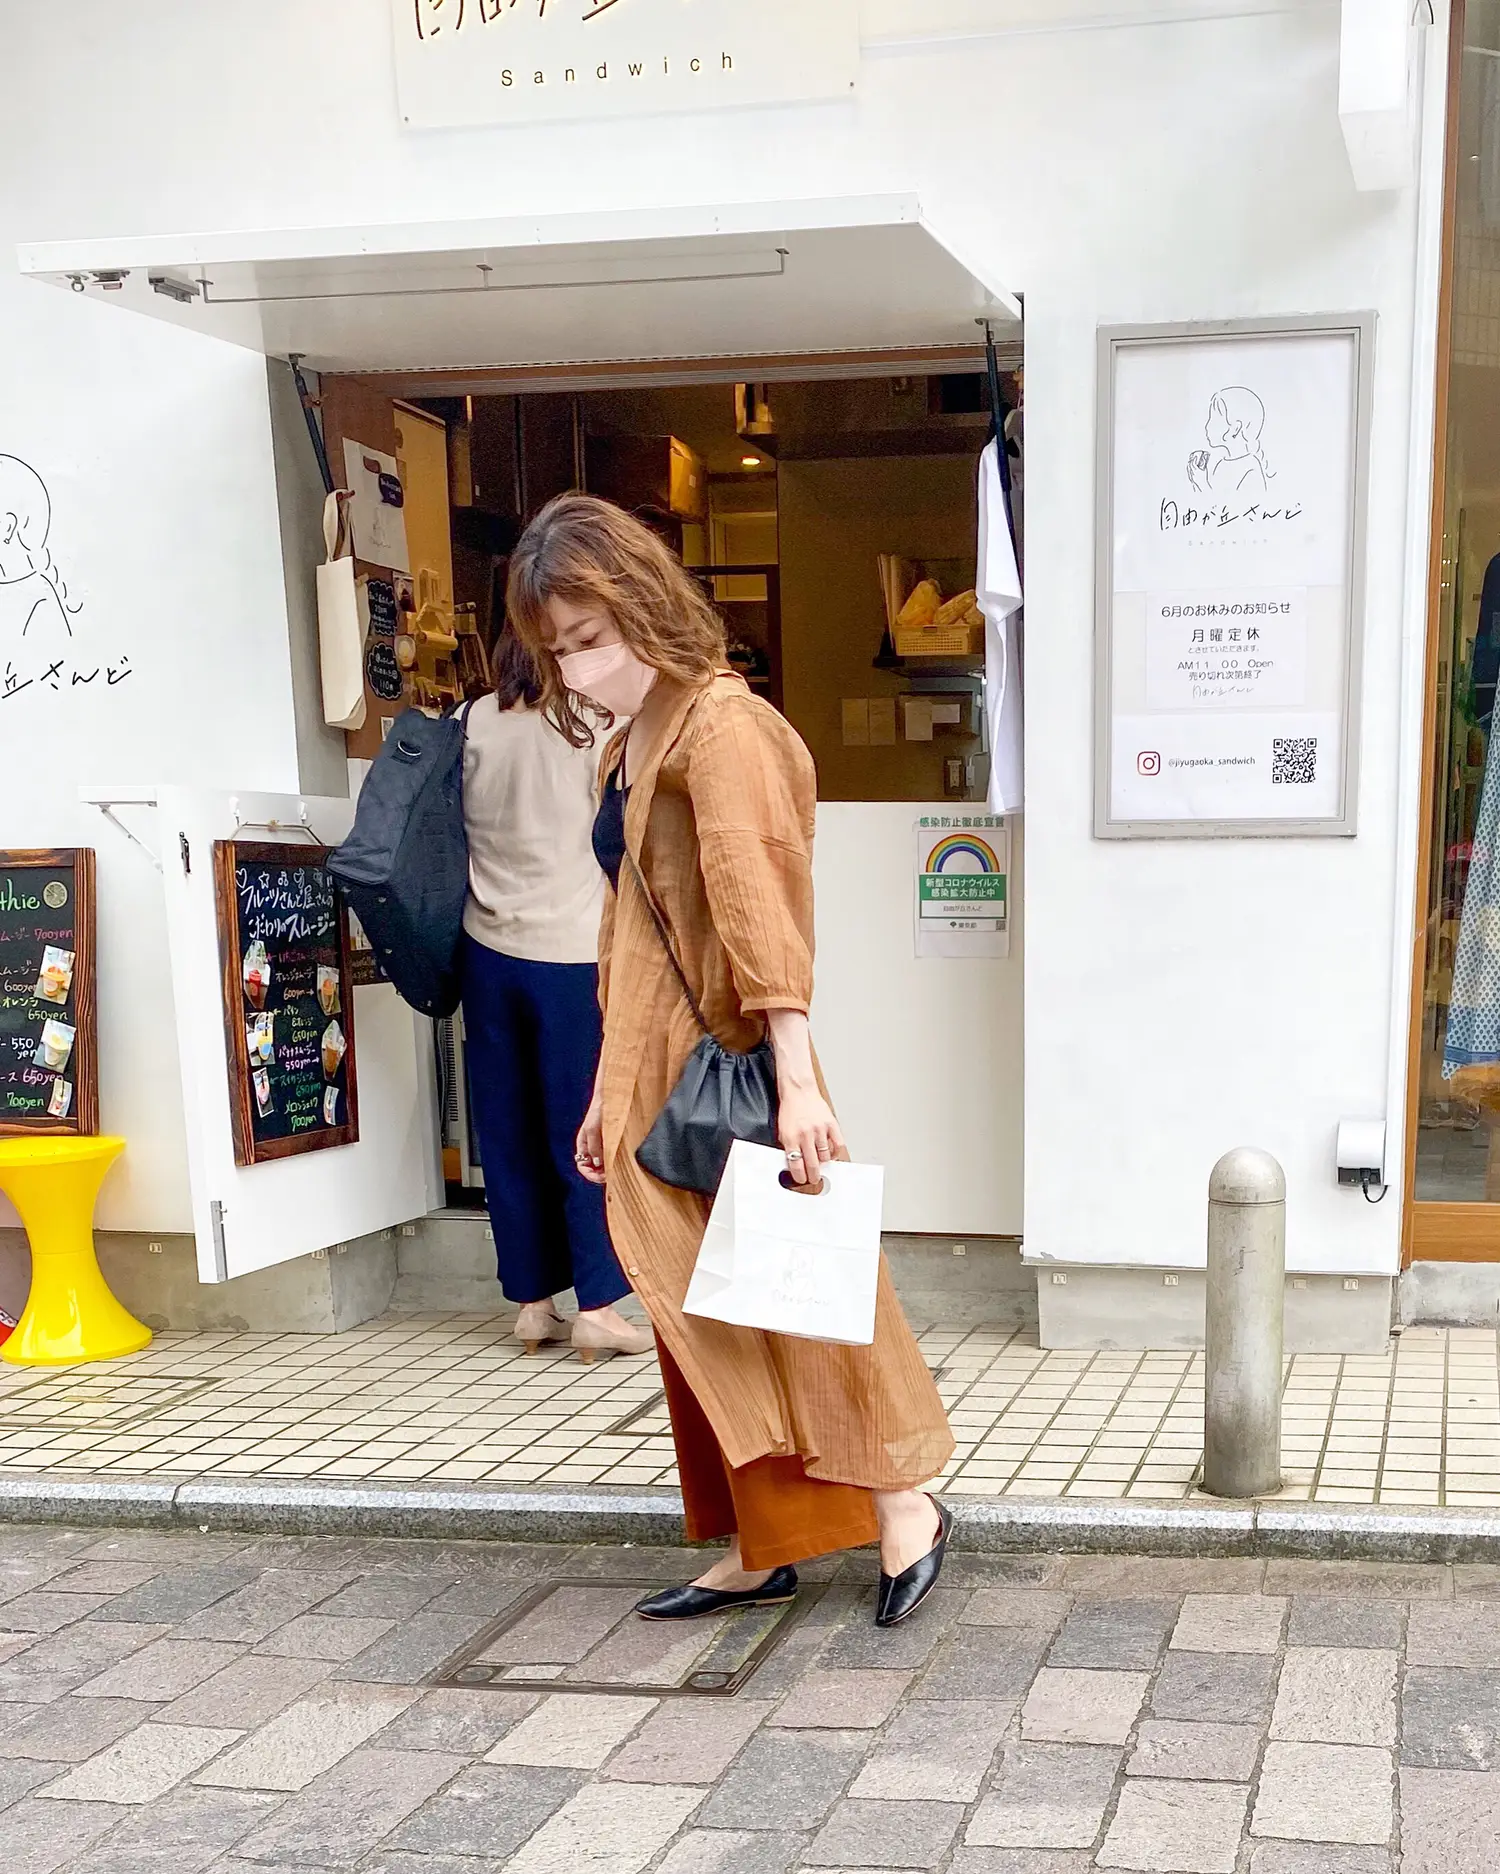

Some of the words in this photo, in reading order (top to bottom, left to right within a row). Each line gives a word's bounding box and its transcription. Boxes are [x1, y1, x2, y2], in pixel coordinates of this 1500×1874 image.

[500, 52, 733, 87] Sandwich
[1160, 497, 1303, 531] 自由が丘さんど
[1161, 602, 1291, 618] 6月のお休みのお知らせ
[1191, 627, 1261, 643] 月曜定休
[1247, 658, 1274, 669] Open
[1189, 670, 1262, 681] 売り切れ次第終了
[1168, 757, 1256, 768] @jiyugaoka_sandwich
[926, 878, 1000, 888] 新型コロナウイルス
[931, 888, 996, 898] 感染拡大防止中
[11, 1037, 34, 1050] 550
